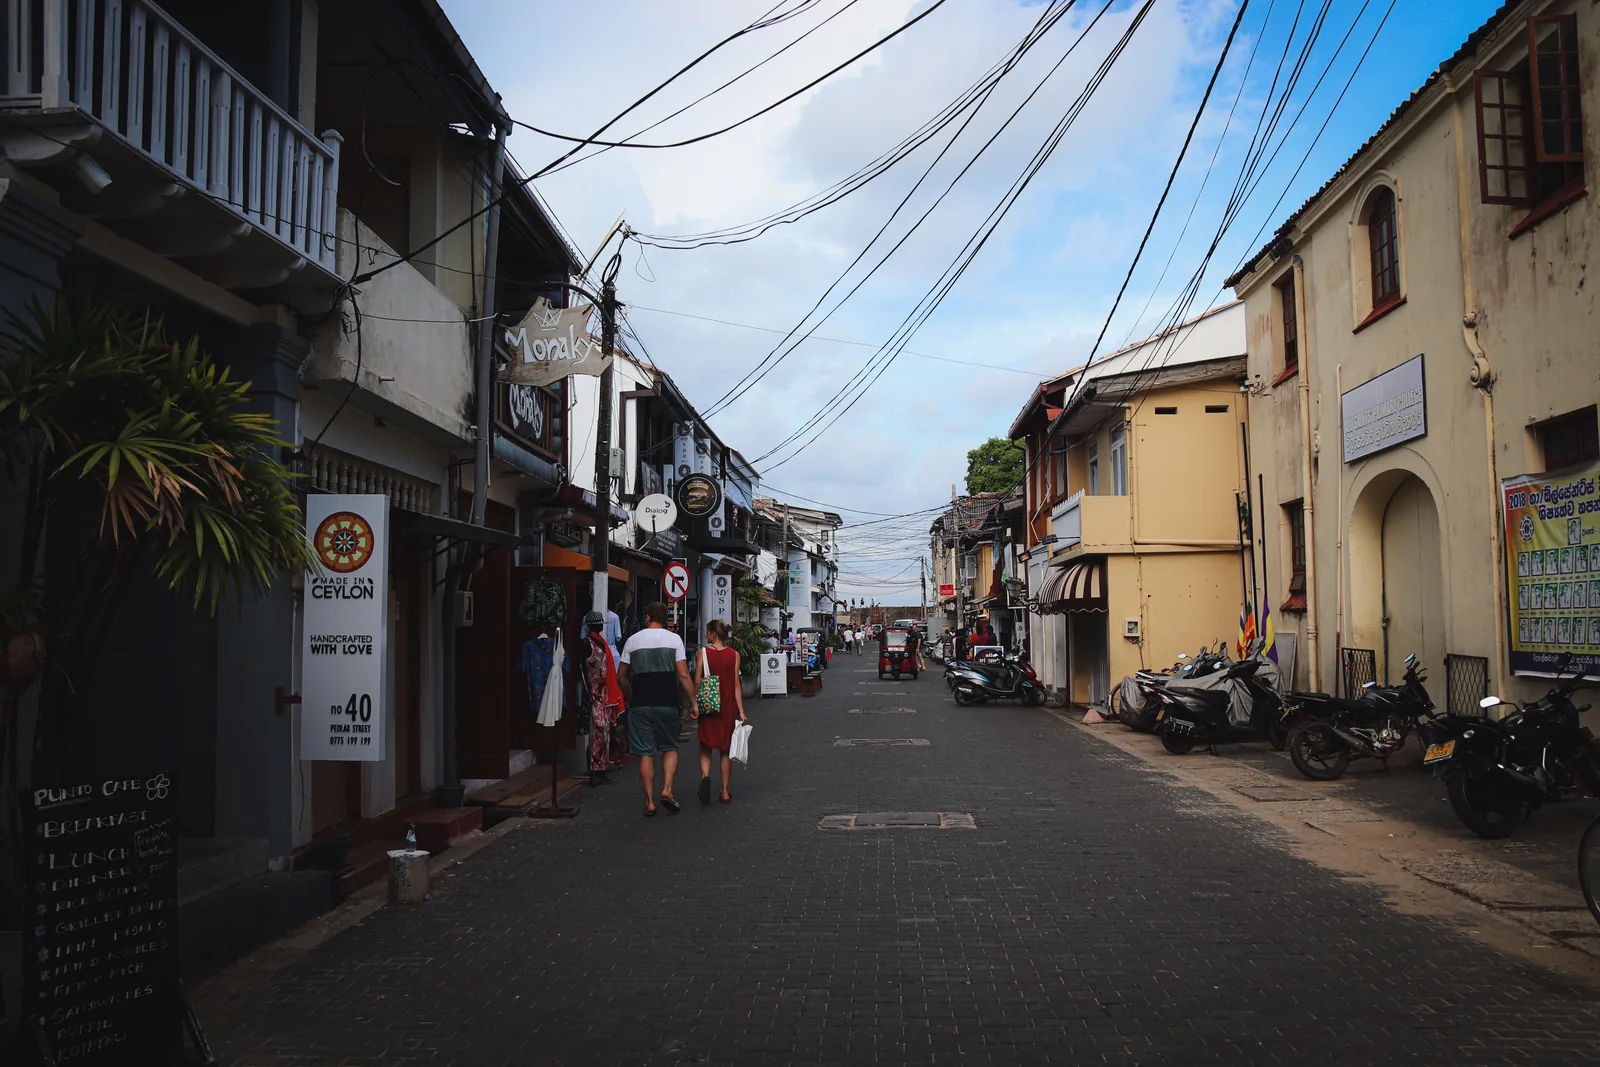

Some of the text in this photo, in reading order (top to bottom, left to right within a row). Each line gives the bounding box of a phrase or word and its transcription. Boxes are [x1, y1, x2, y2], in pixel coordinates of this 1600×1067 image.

[504, 322, 594, 368] Monaky
[1373, 397, 1397, 423] PRIMARY
[1398, 385, 1422, 411] COLLEGE
[1508, 492, 1526, 510] 2018
[321, 577, 365, 585] MADE IN
[311, 585, 374, 600] CEYLON
[310, 634, 372, 644] HANDCRAFTED
[310, 644, 373, 655] WITH LOVE
[330, 693, 372, 722] no 40
[330, 724, 371, 734] PEDLAR STREET
[330, 736, 371, 745] 0775 199 199
[34, 779, 142, 806] PUNTO CAFE
[44, 810, 149, 838] BREAKFAST
[49, 847, 130, 870] LUNCH
[52, 866, 132, 892] DINNER
[56, 896, 90, 912] RICE
